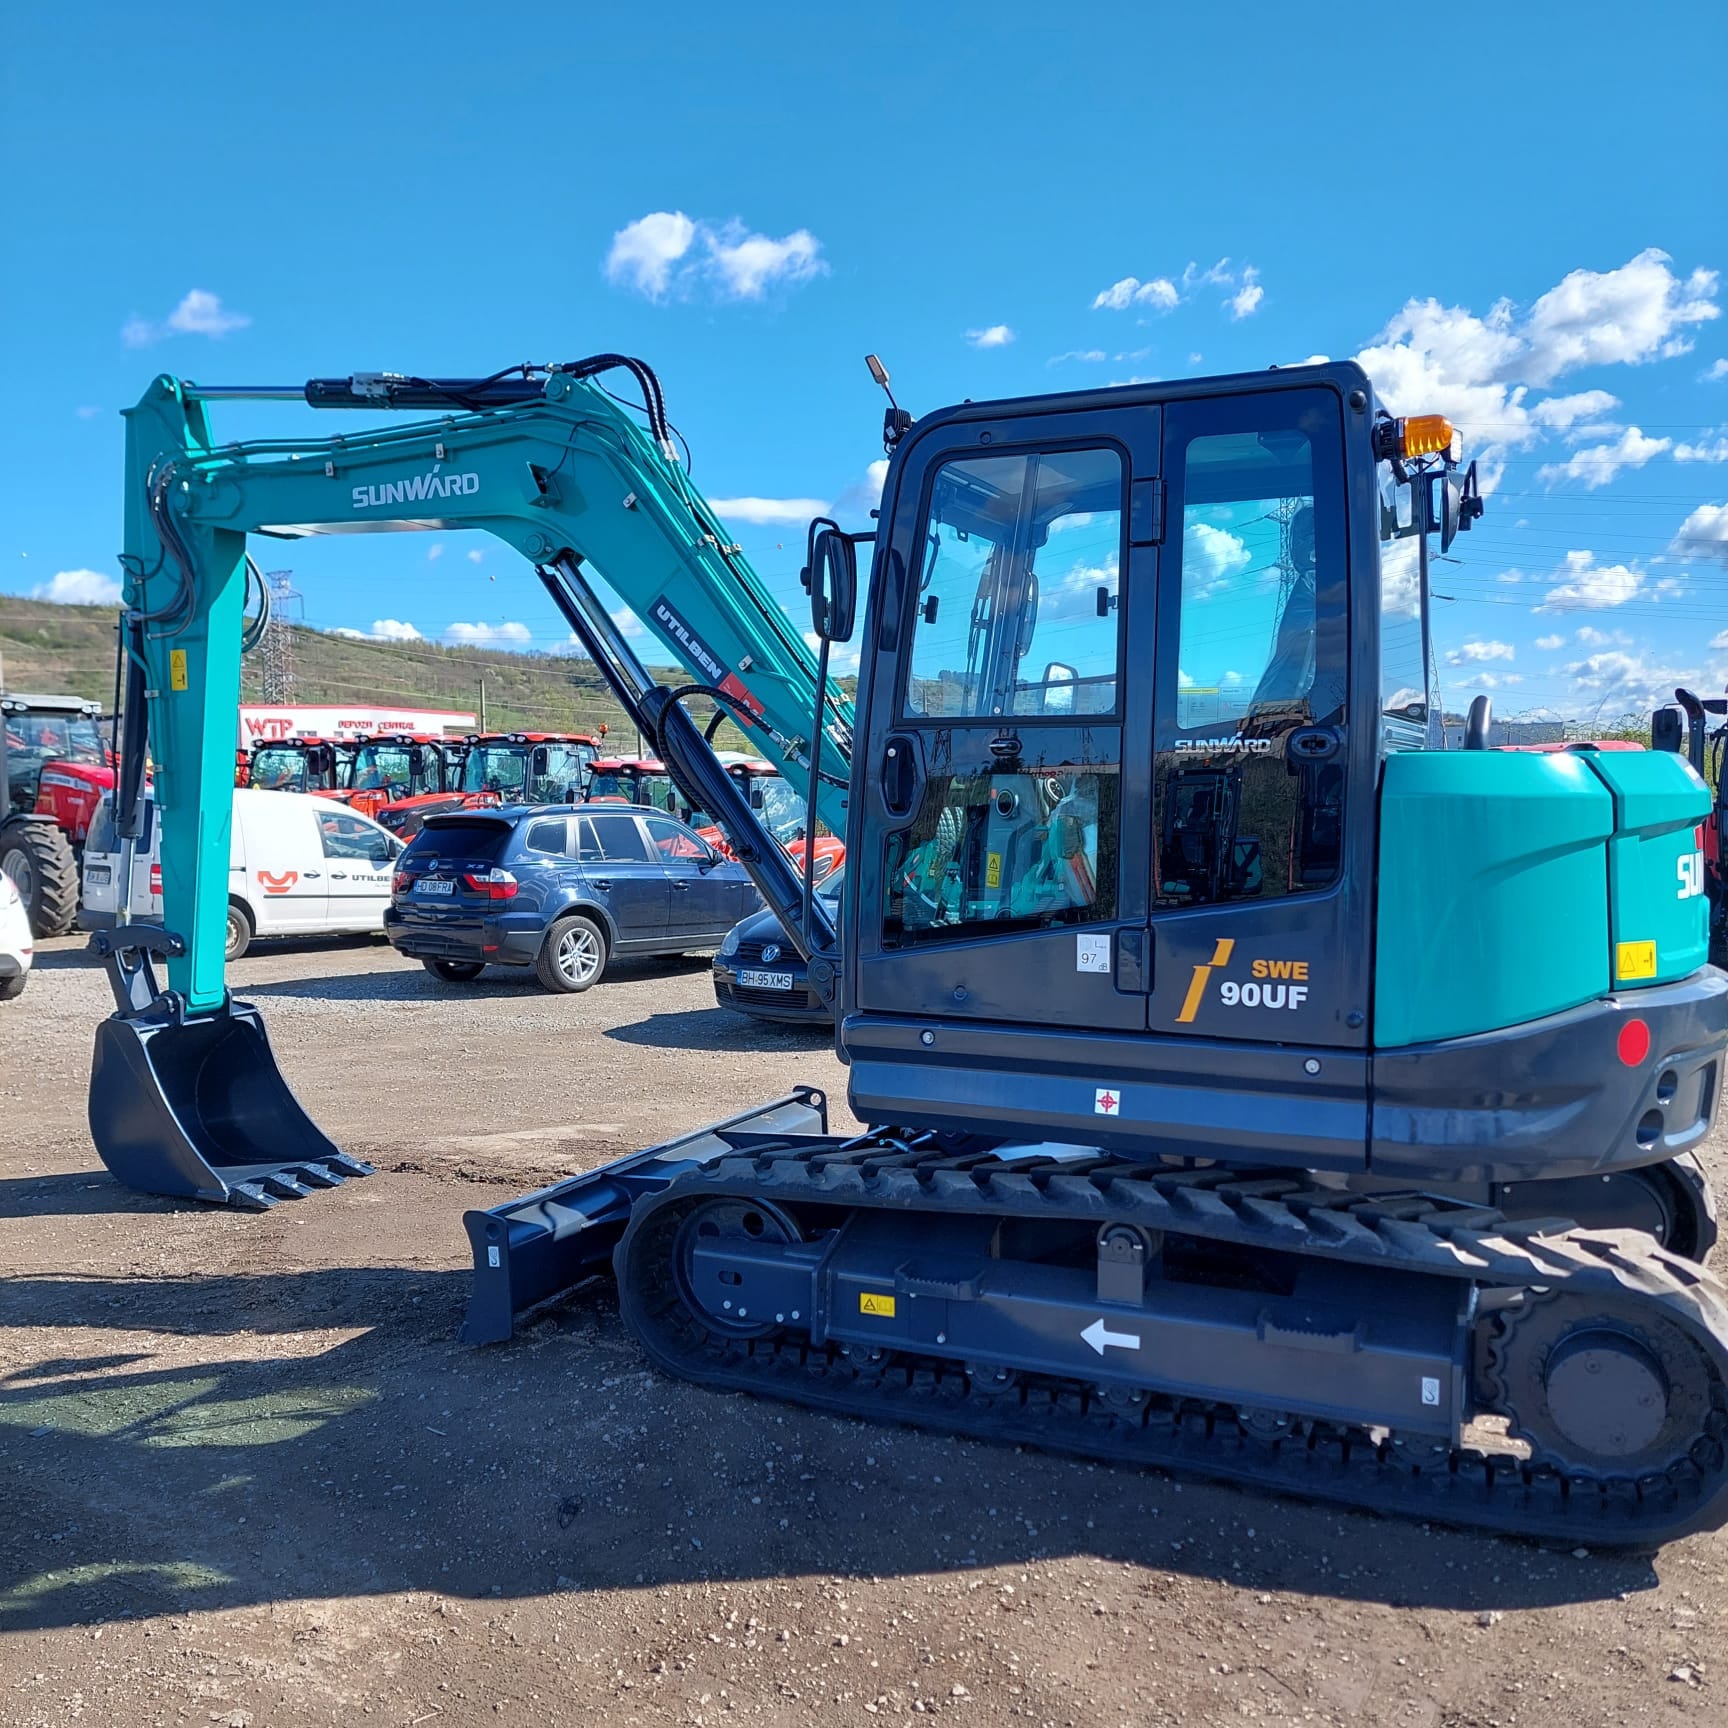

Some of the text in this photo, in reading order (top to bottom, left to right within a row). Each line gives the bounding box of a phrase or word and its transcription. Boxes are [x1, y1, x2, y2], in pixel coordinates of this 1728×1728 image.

[352, 464, 480, 508] SUNWARD
[656, 604, 722, 680] UTILBEN
[245, 717, 293, 738] WTP
[1175, 731, 1271, 753] SUNWARD
[352, 874, 391, 882] UTILBE
[1081, 952, 1097, 964] 97
[742, 971, 791, 988] BH 95 XMS
[1252, 959, 1309, 981] SWE
[1220, 982, 1308, 1010] 90UF
